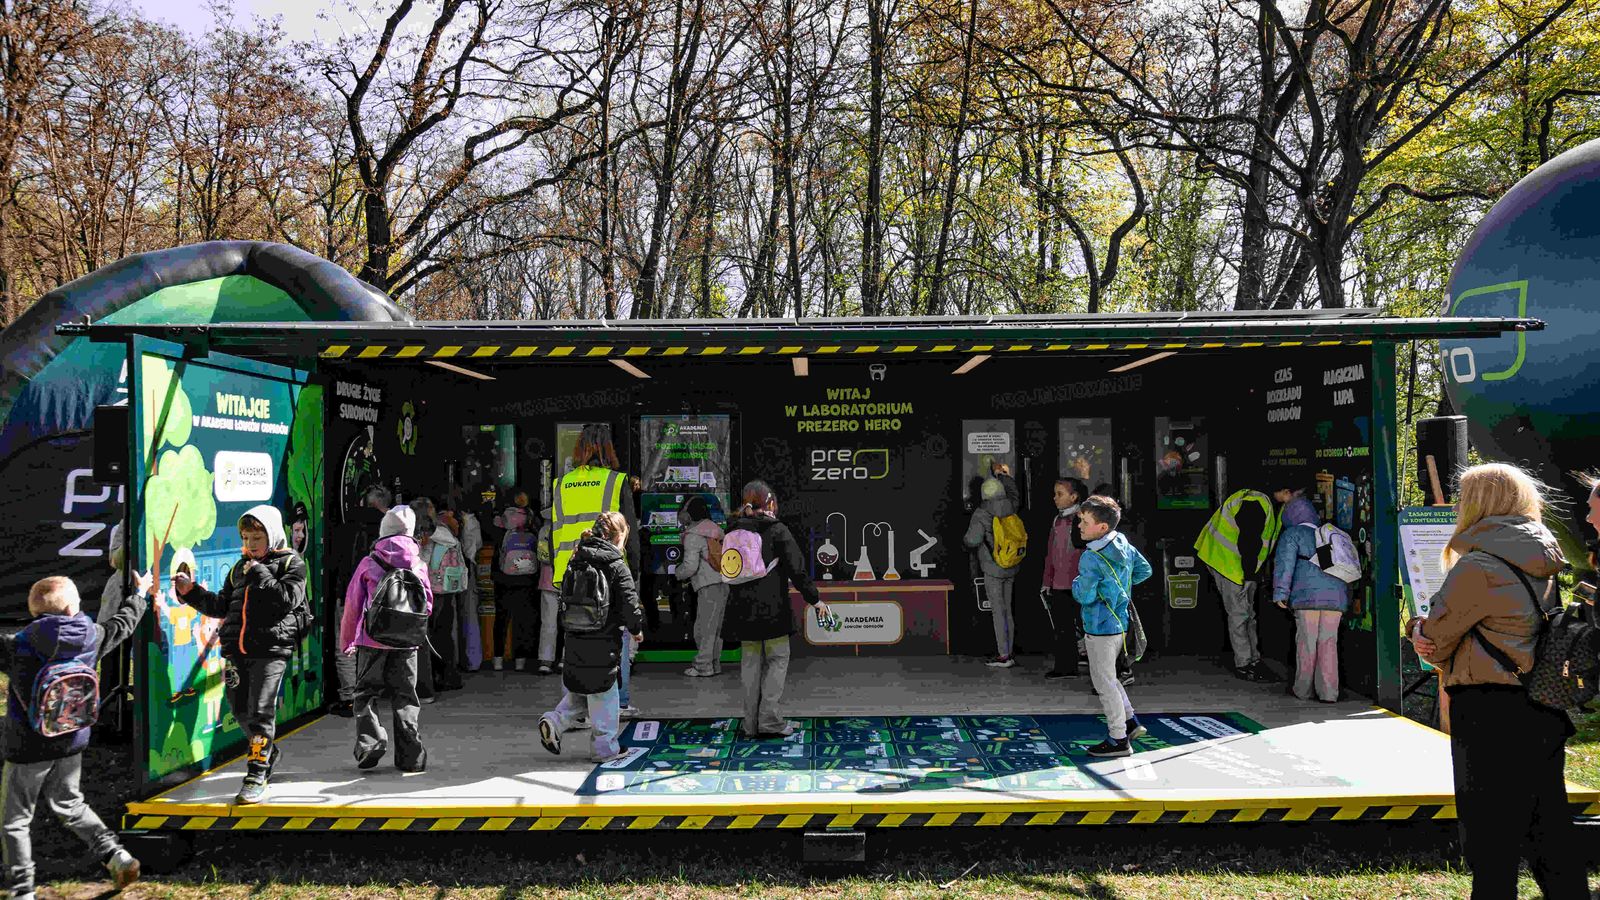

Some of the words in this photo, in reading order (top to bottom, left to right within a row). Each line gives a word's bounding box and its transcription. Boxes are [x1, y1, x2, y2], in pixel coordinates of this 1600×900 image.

[1274, 367, 1293, 384] CZAS
[1323, 363, 1365, 386] MAGICZNA
[336, 380, 362, 400] DRUGIE
[363, 383, 382, 403] ŻYCIE
[826, 387, 871, 401] WITAJ
[1266, 385, 1302, 405] ROZKŁADU
[1333, 388, 1355, 406] LUPA
[216, 391, 271, 419] WITAJCIE
[339, 403, 379, 423] SUROWCÓW
[785, 405, 798, 417] W
[802, 402, 914, 417] LABORATORIUM
[1267, 402, 1302, 423] ODPADÓW
[192, 415, 201, 427] W
[797, 420, 860, 433] PREZERO
[865, 418, 902, 431] HERO
[811, 449, 852, 466] pre
[811, 467, 868, 480] zero
